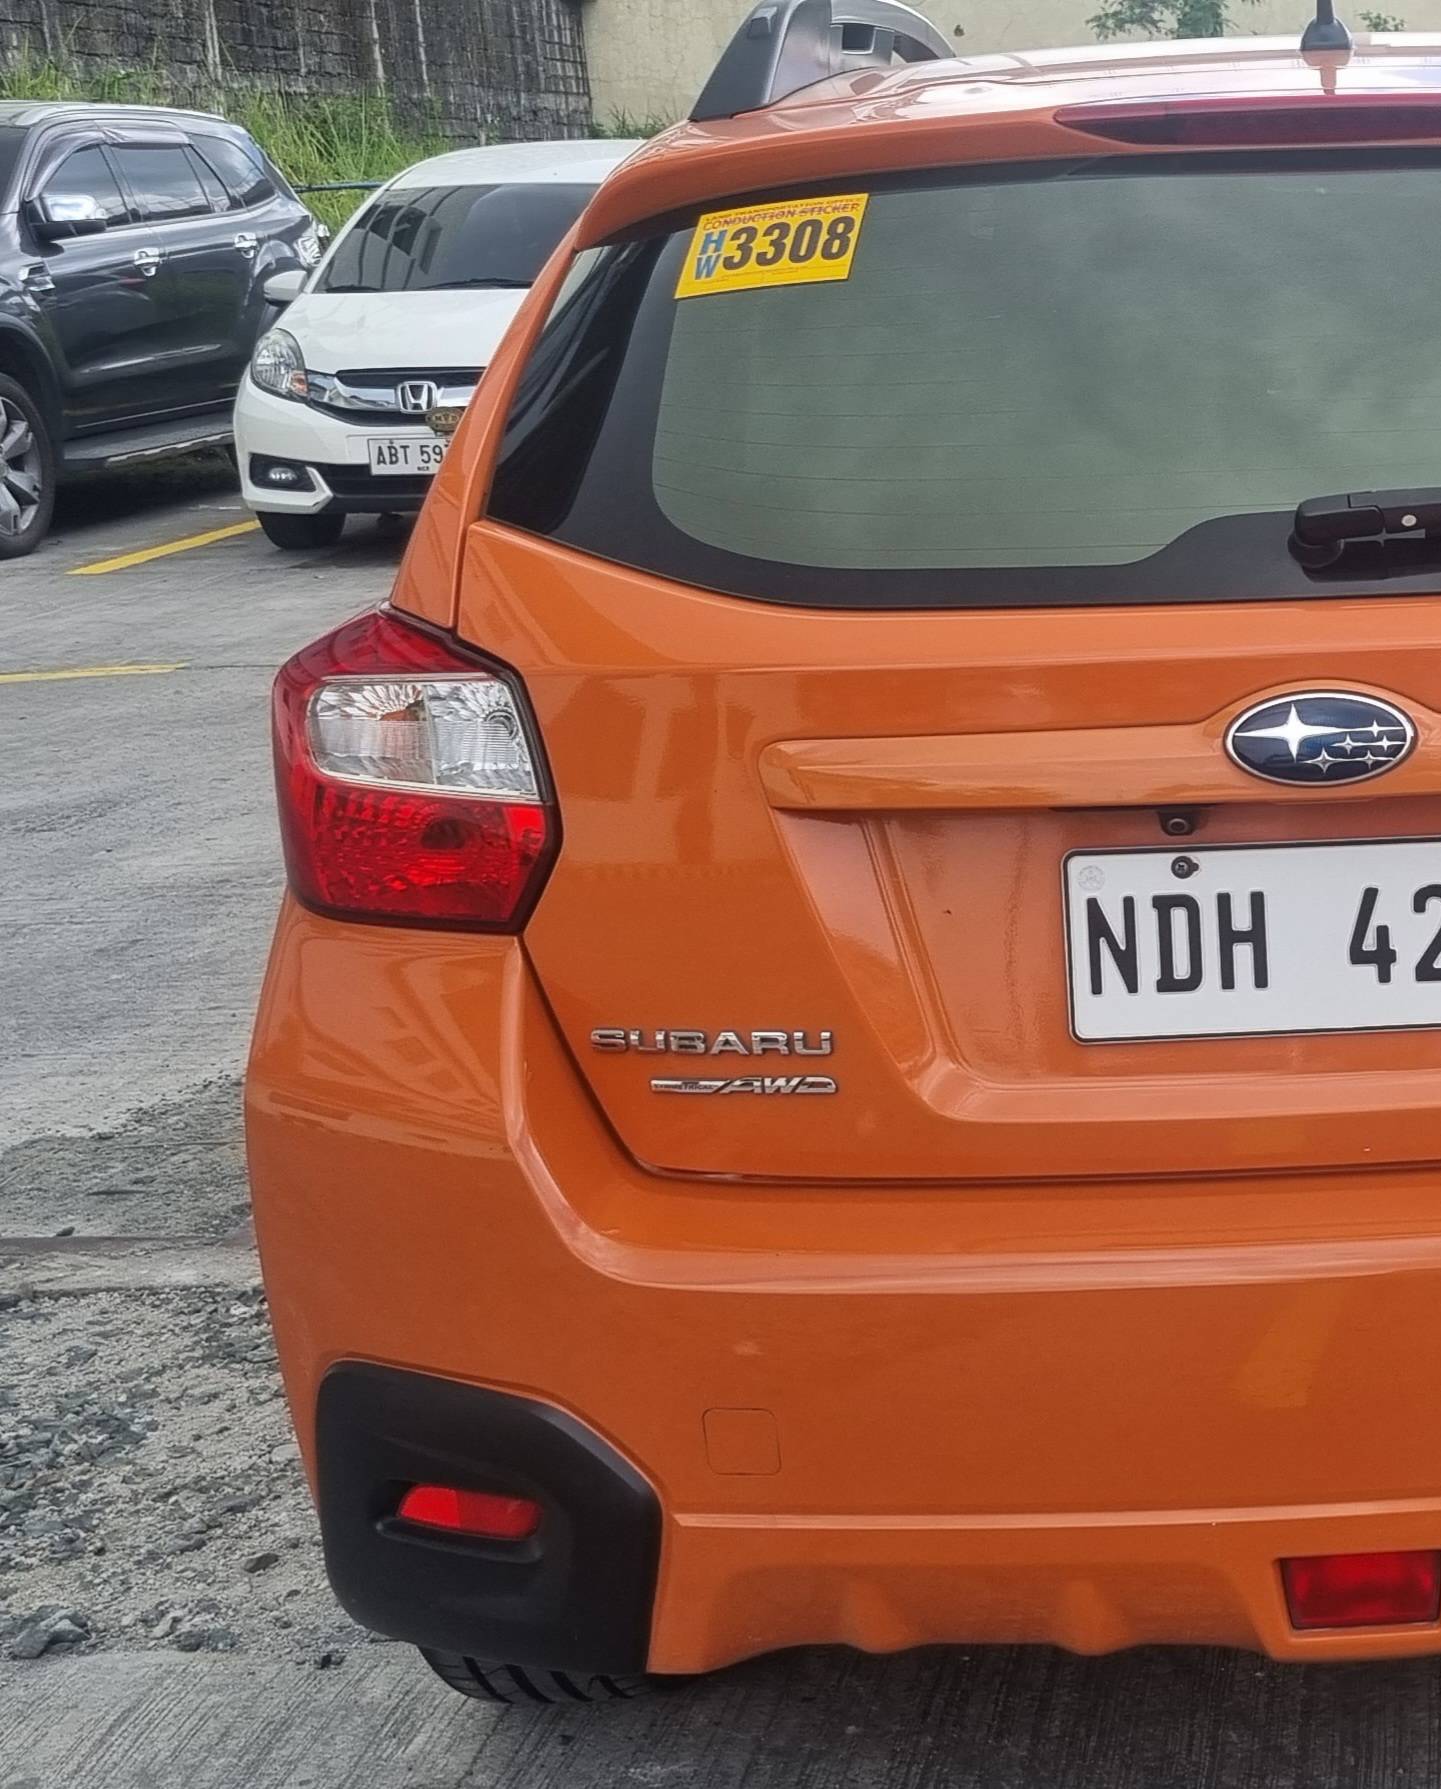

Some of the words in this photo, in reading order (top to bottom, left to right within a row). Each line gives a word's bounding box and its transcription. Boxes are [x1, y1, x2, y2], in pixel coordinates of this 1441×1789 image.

[703, 209, 796, 231] CONDUCTION
[799, 202, 861, 216] STICKER
[701, 229, 727, 255] H
[722, 216, 855, 271] 3308
[694, 254, 722, 281] W
[376, 444, 411, 465] ABT
[419, 444, 450, 464] 59
[1086, 889, 1270, 996] NDH
[590, 1029, 832, 1054] SUBARU
[717, 1076, 837, 1094] AWD
